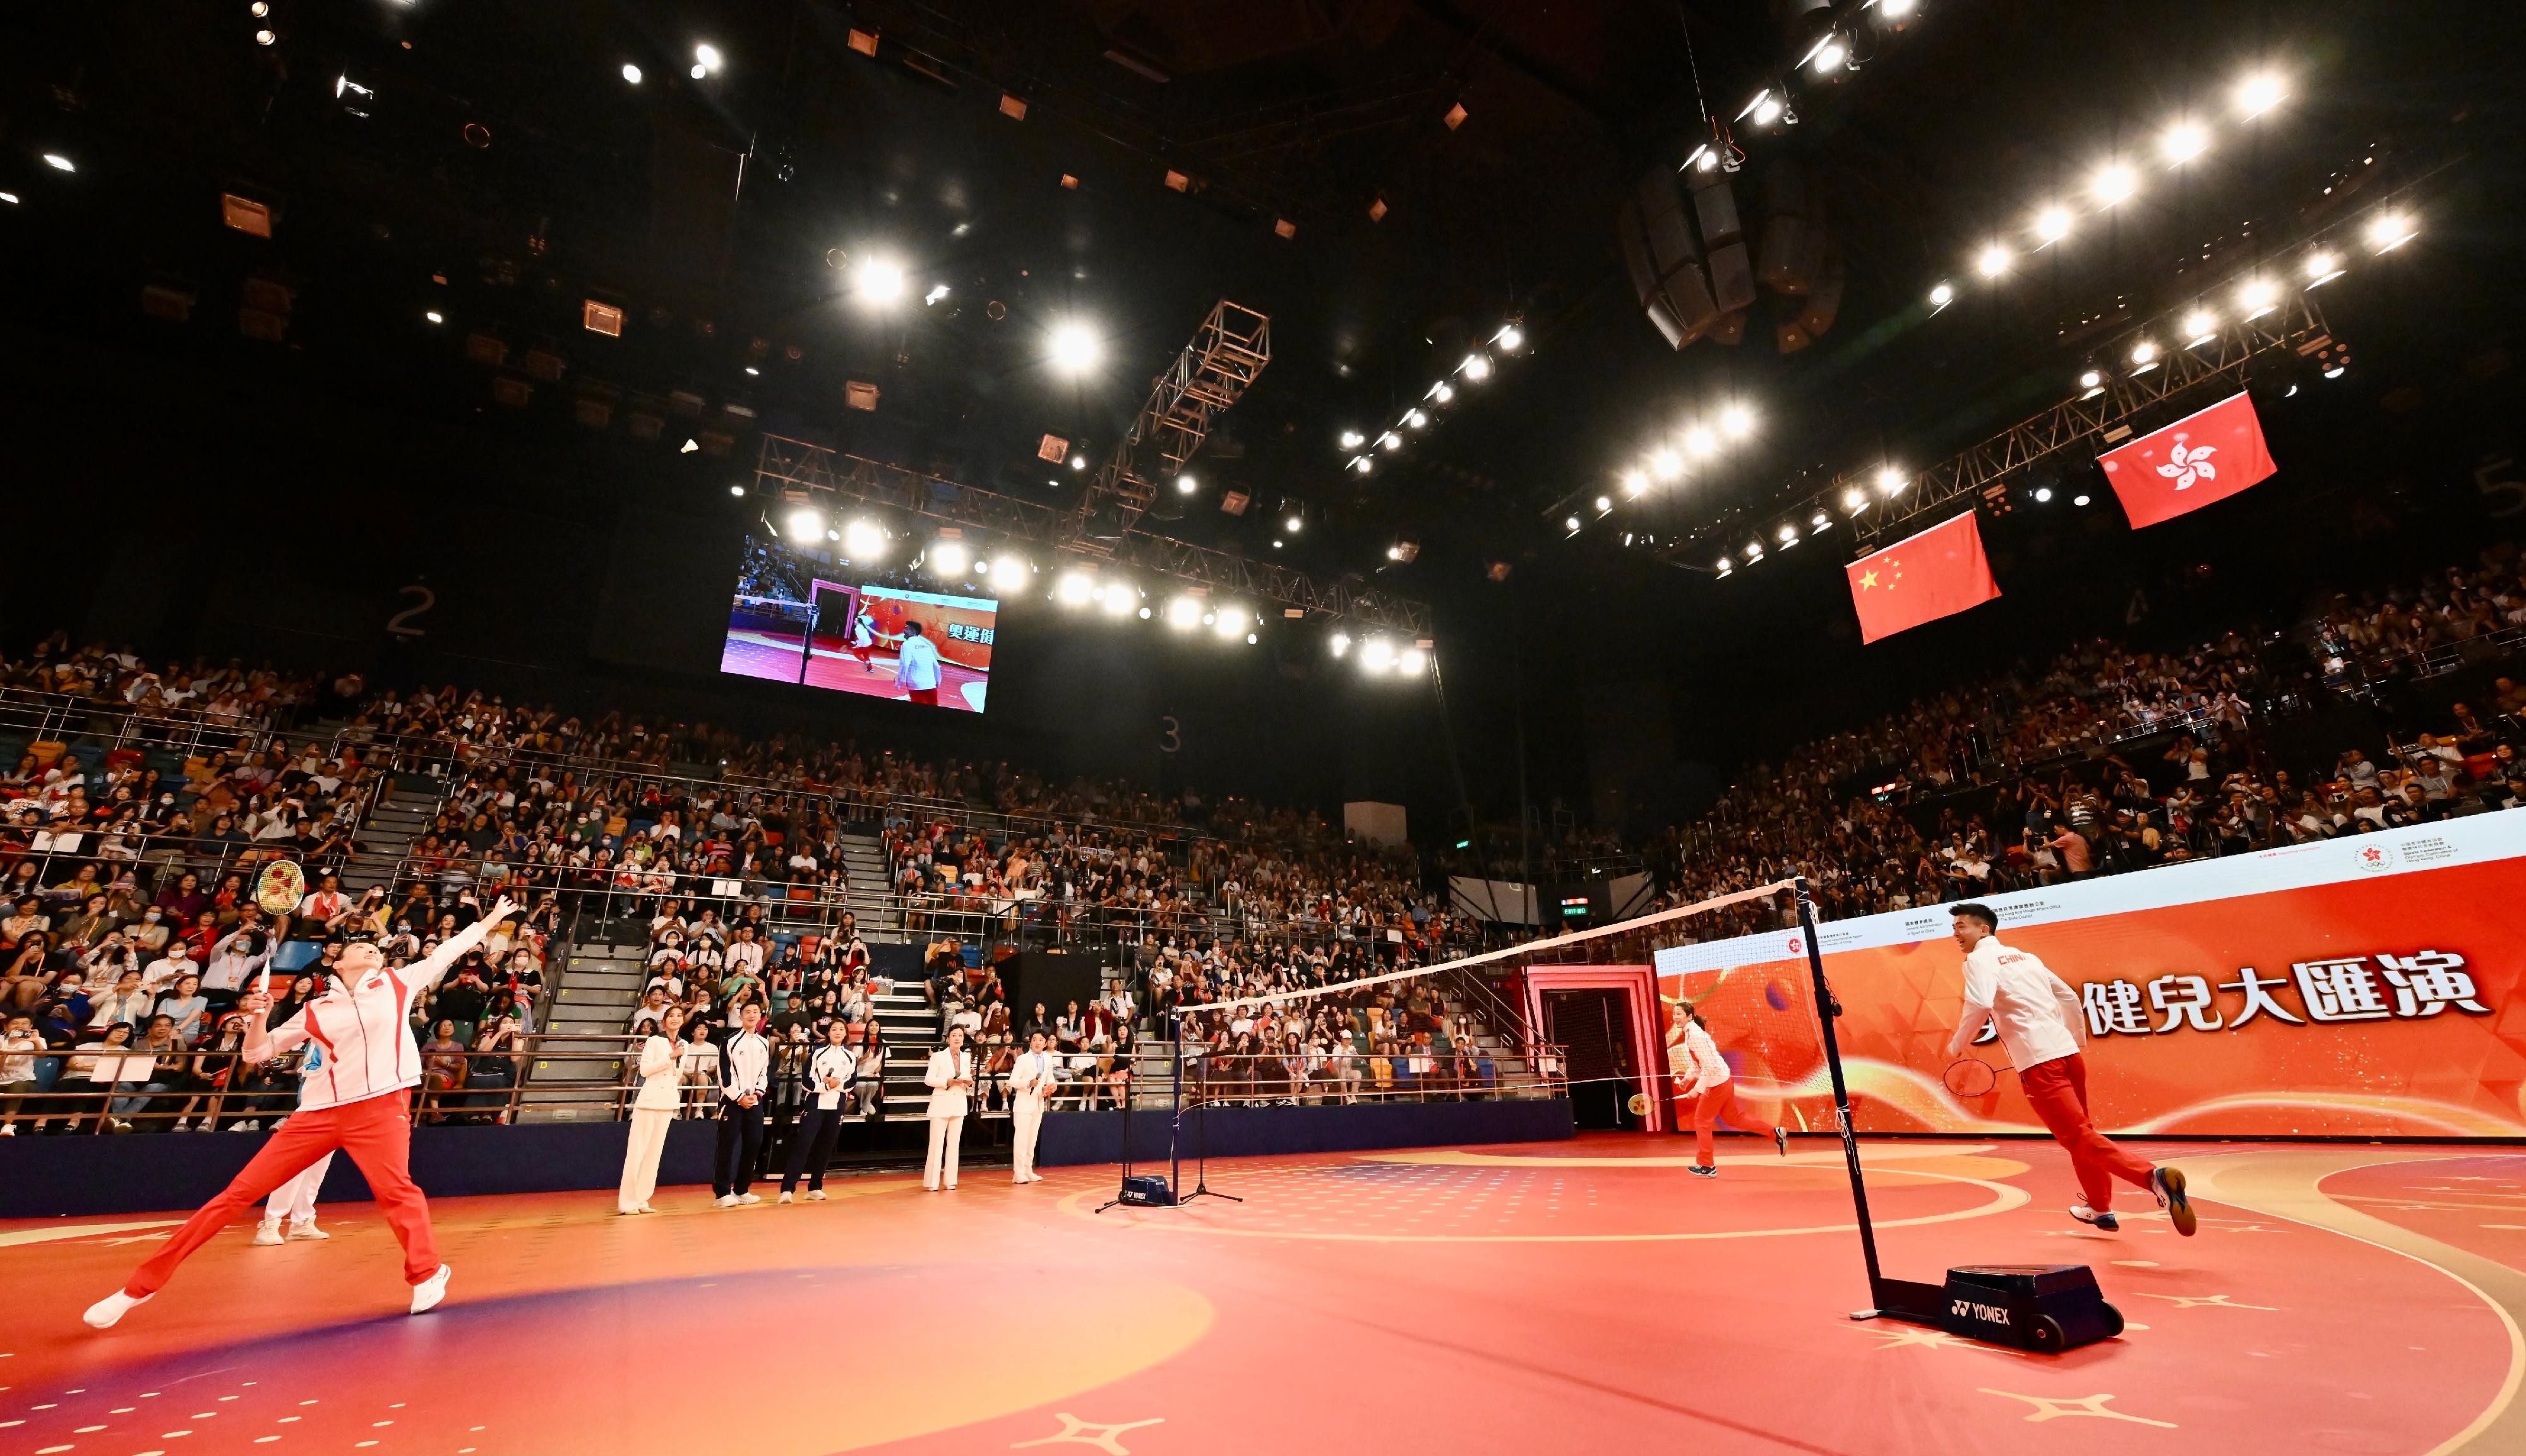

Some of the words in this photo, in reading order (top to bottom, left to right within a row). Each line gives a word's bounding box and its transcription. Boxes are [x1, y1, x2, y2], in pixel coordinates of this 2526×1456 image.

[386, 585, 435, 636] 2
[1159, 715, 1181, 753] 3
[1973, 951, 2490, 1043] 健兒大匯演
[1134, 1191, 1147, 1200] YONEX
[1972, 1303, 2010, 1325] YONEX
